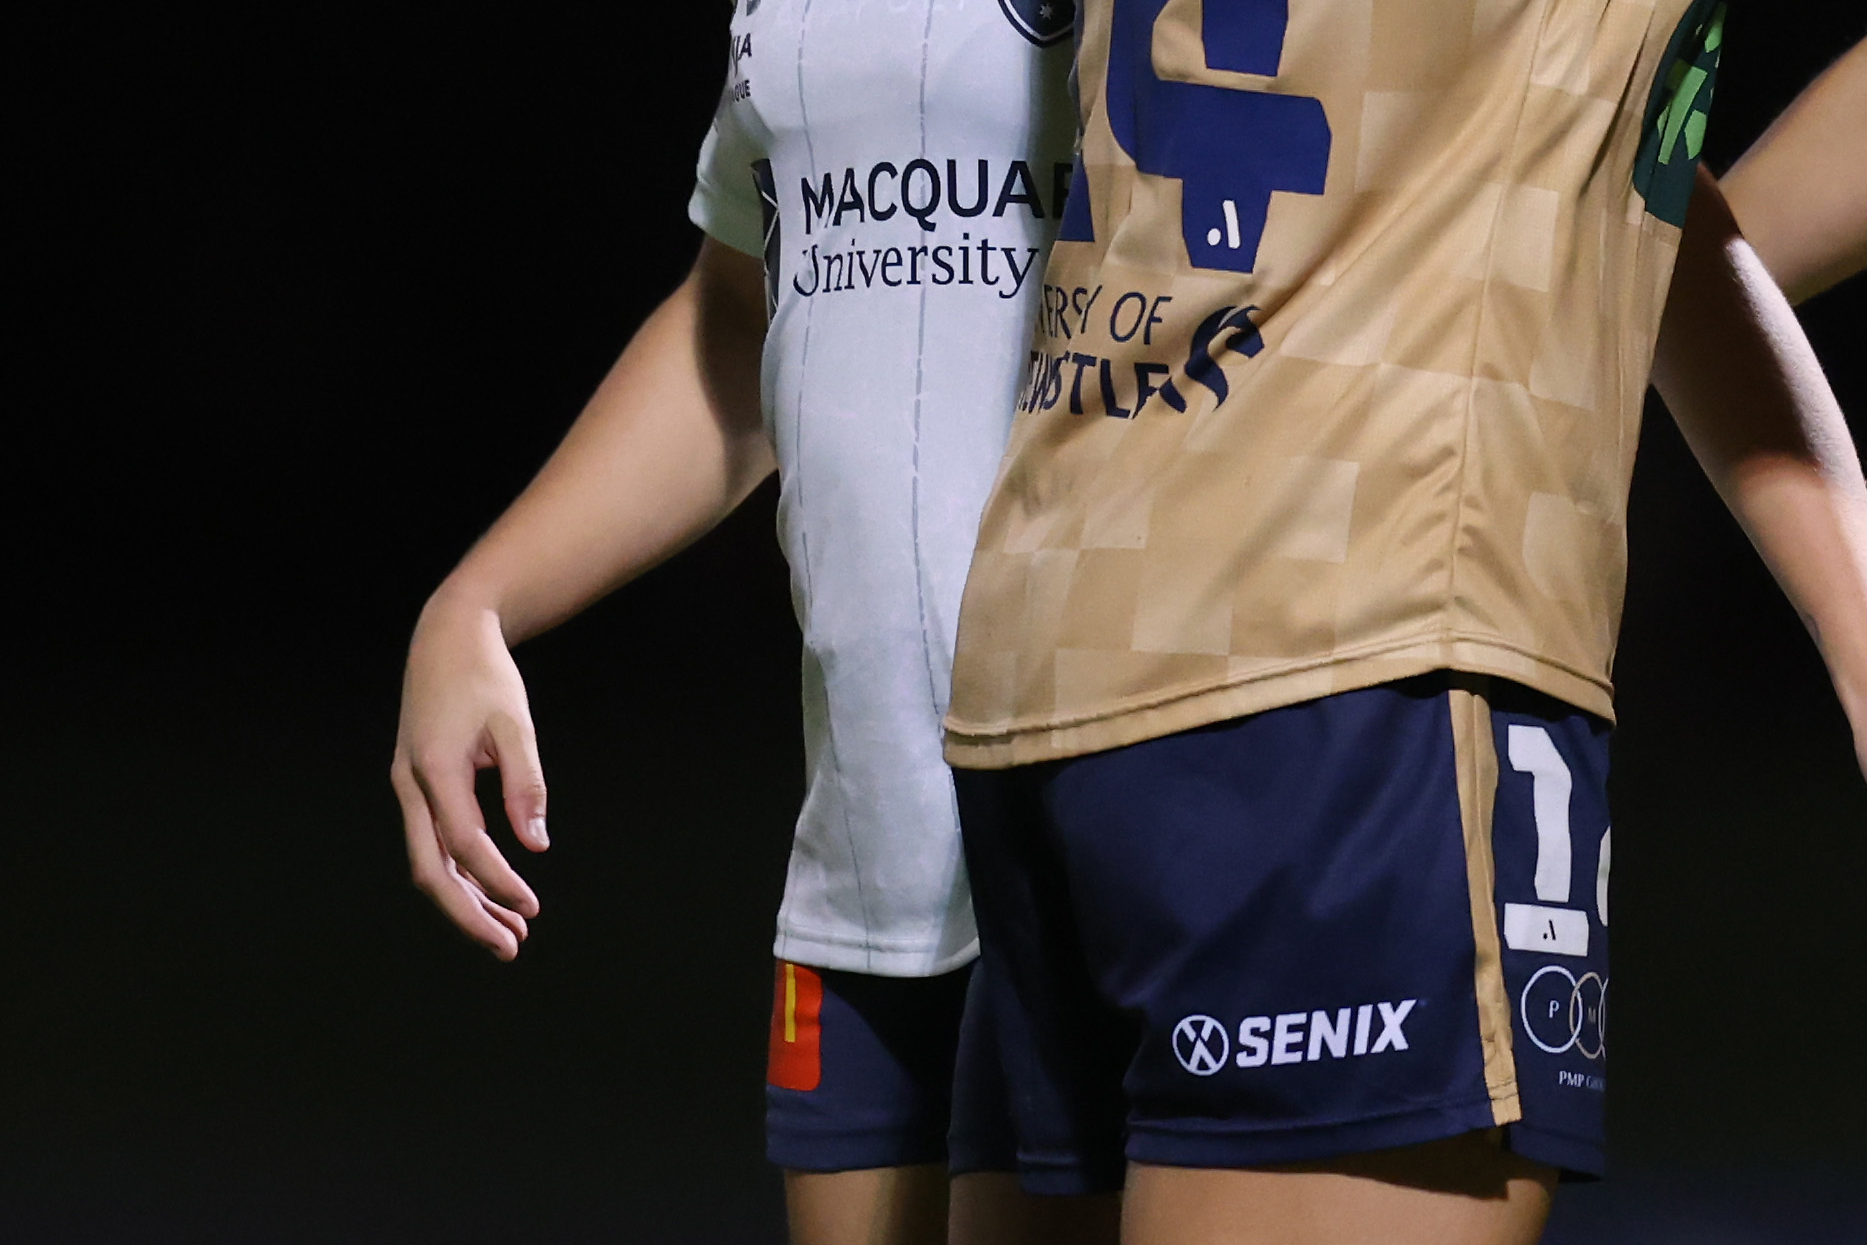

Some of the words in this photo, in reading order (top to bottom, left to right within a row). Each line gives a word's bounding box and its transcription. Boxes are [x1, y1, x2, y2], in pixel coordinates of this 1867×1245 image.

[793, 232, 1040, 299] University
[1110, 292, 1174, 345] OF
[1236, 999, 1417, 1068] SENIX
[1558, 1070, 1585, 1088] PMP
